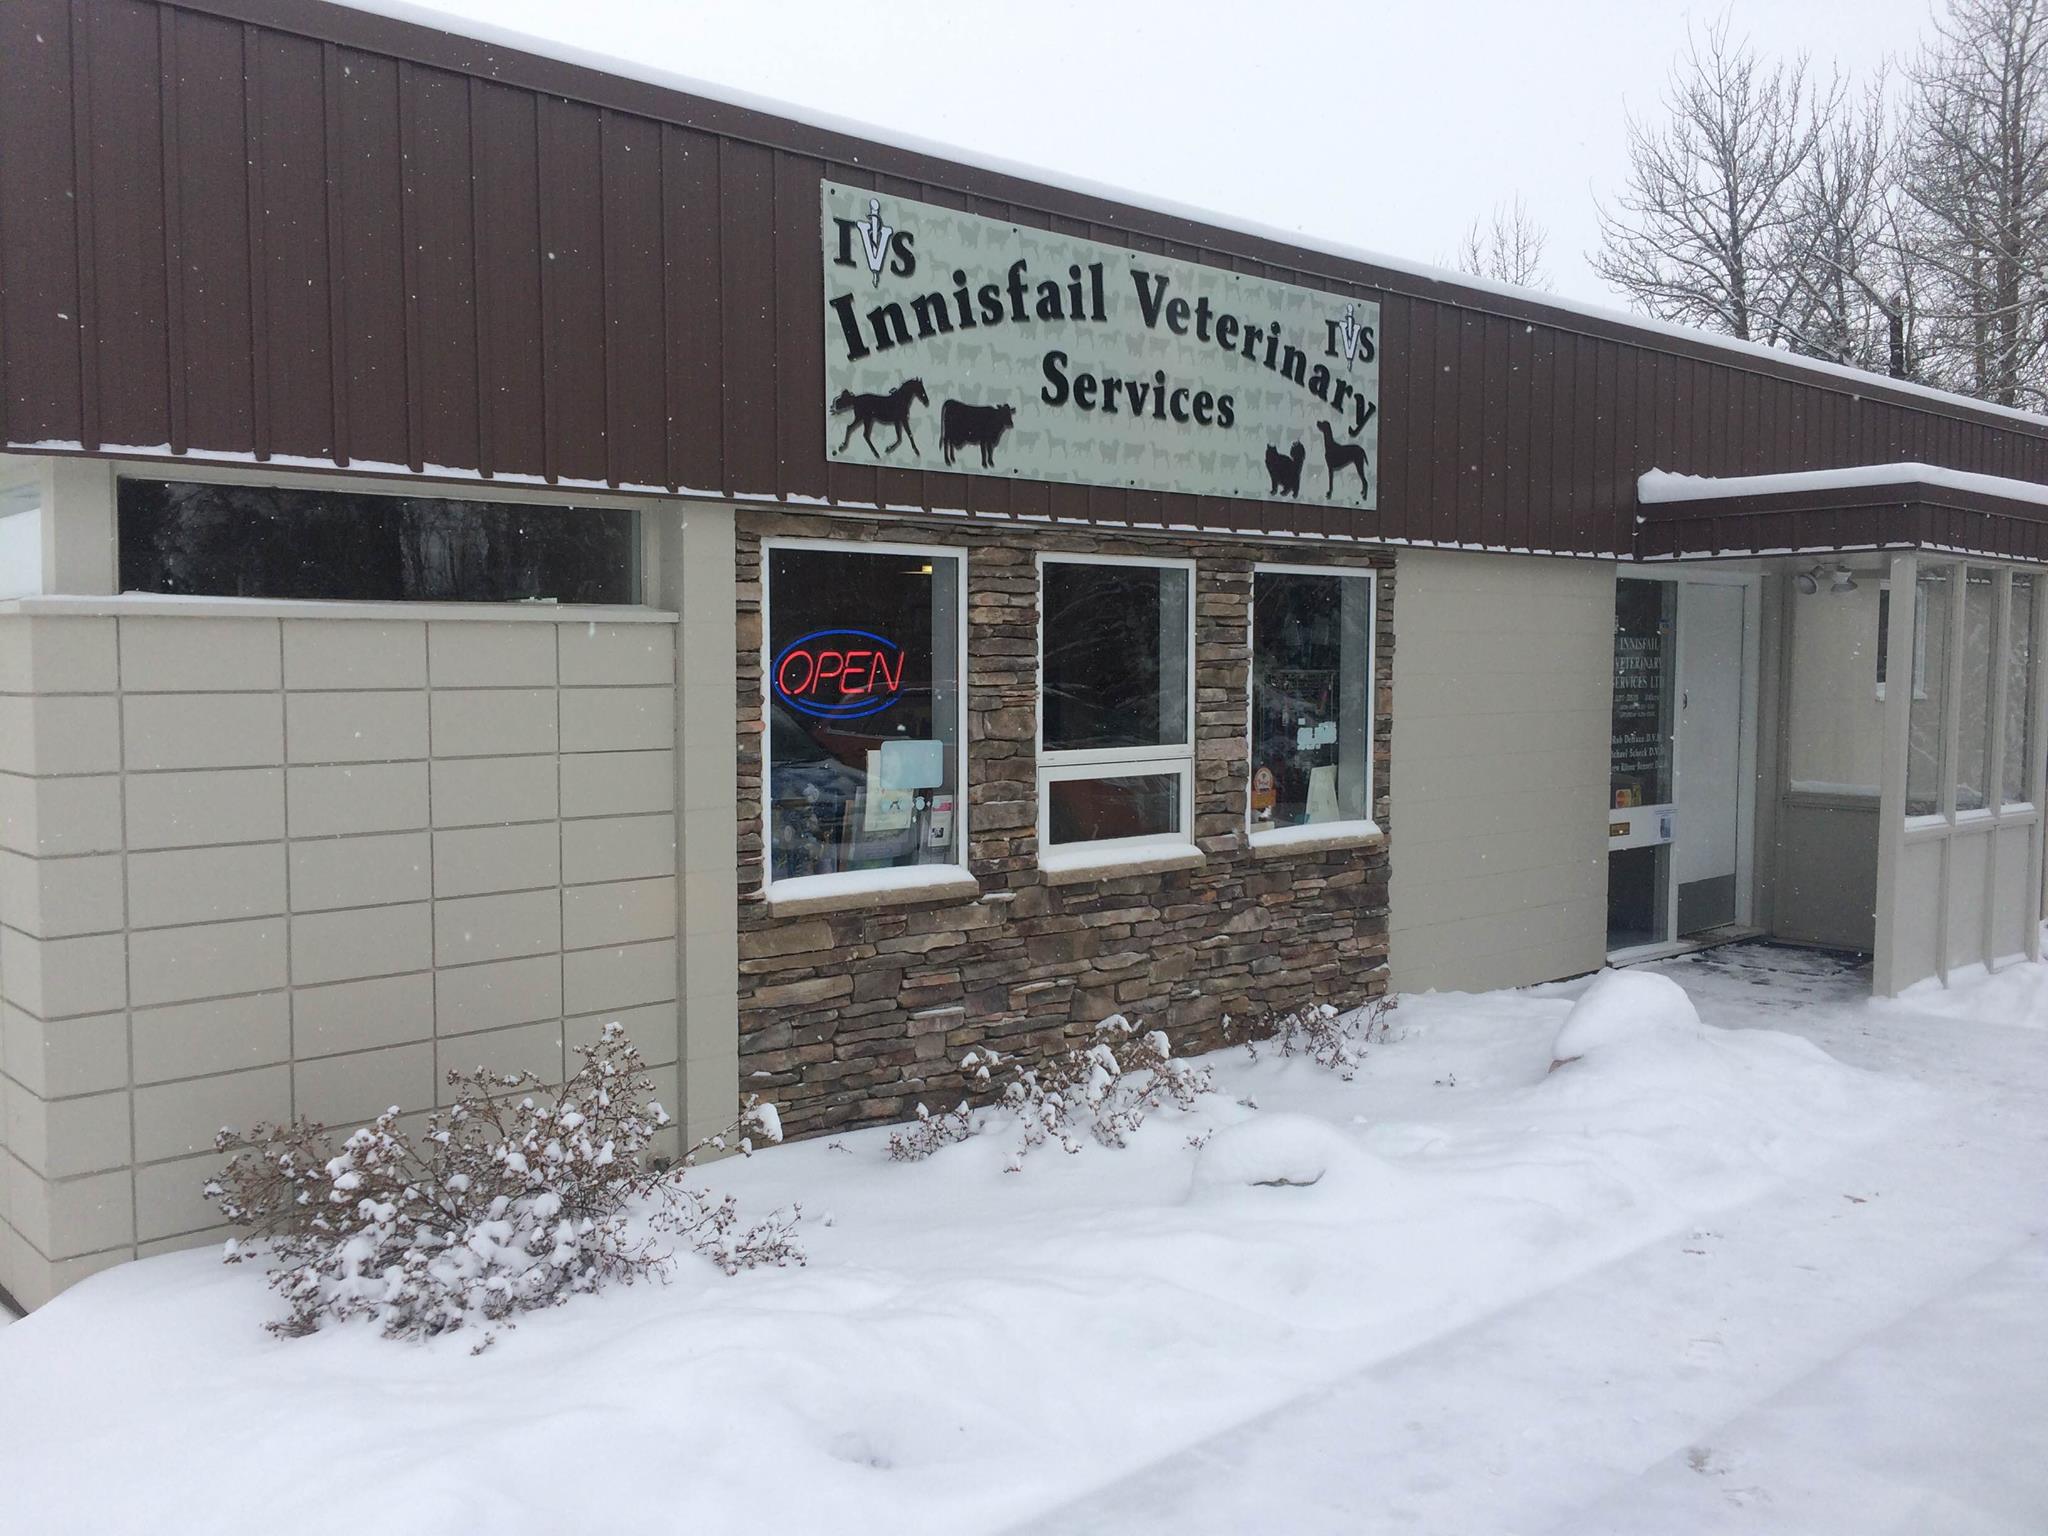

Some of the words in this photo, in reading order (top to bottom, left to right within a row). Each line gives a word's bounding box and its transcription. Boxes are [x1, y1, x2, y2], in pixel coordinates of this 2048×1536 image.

[829, 258, 1108, 362] Innisfail
[1129, 269, 1377, 436] Veterinary
[1040, 349, 1236, 429] Services
[1620, 637, 1660, 650] INNISFAIL
[779, 650, 905, 695] OPEN
[1615, 675, 1648, 688] ERVICES
